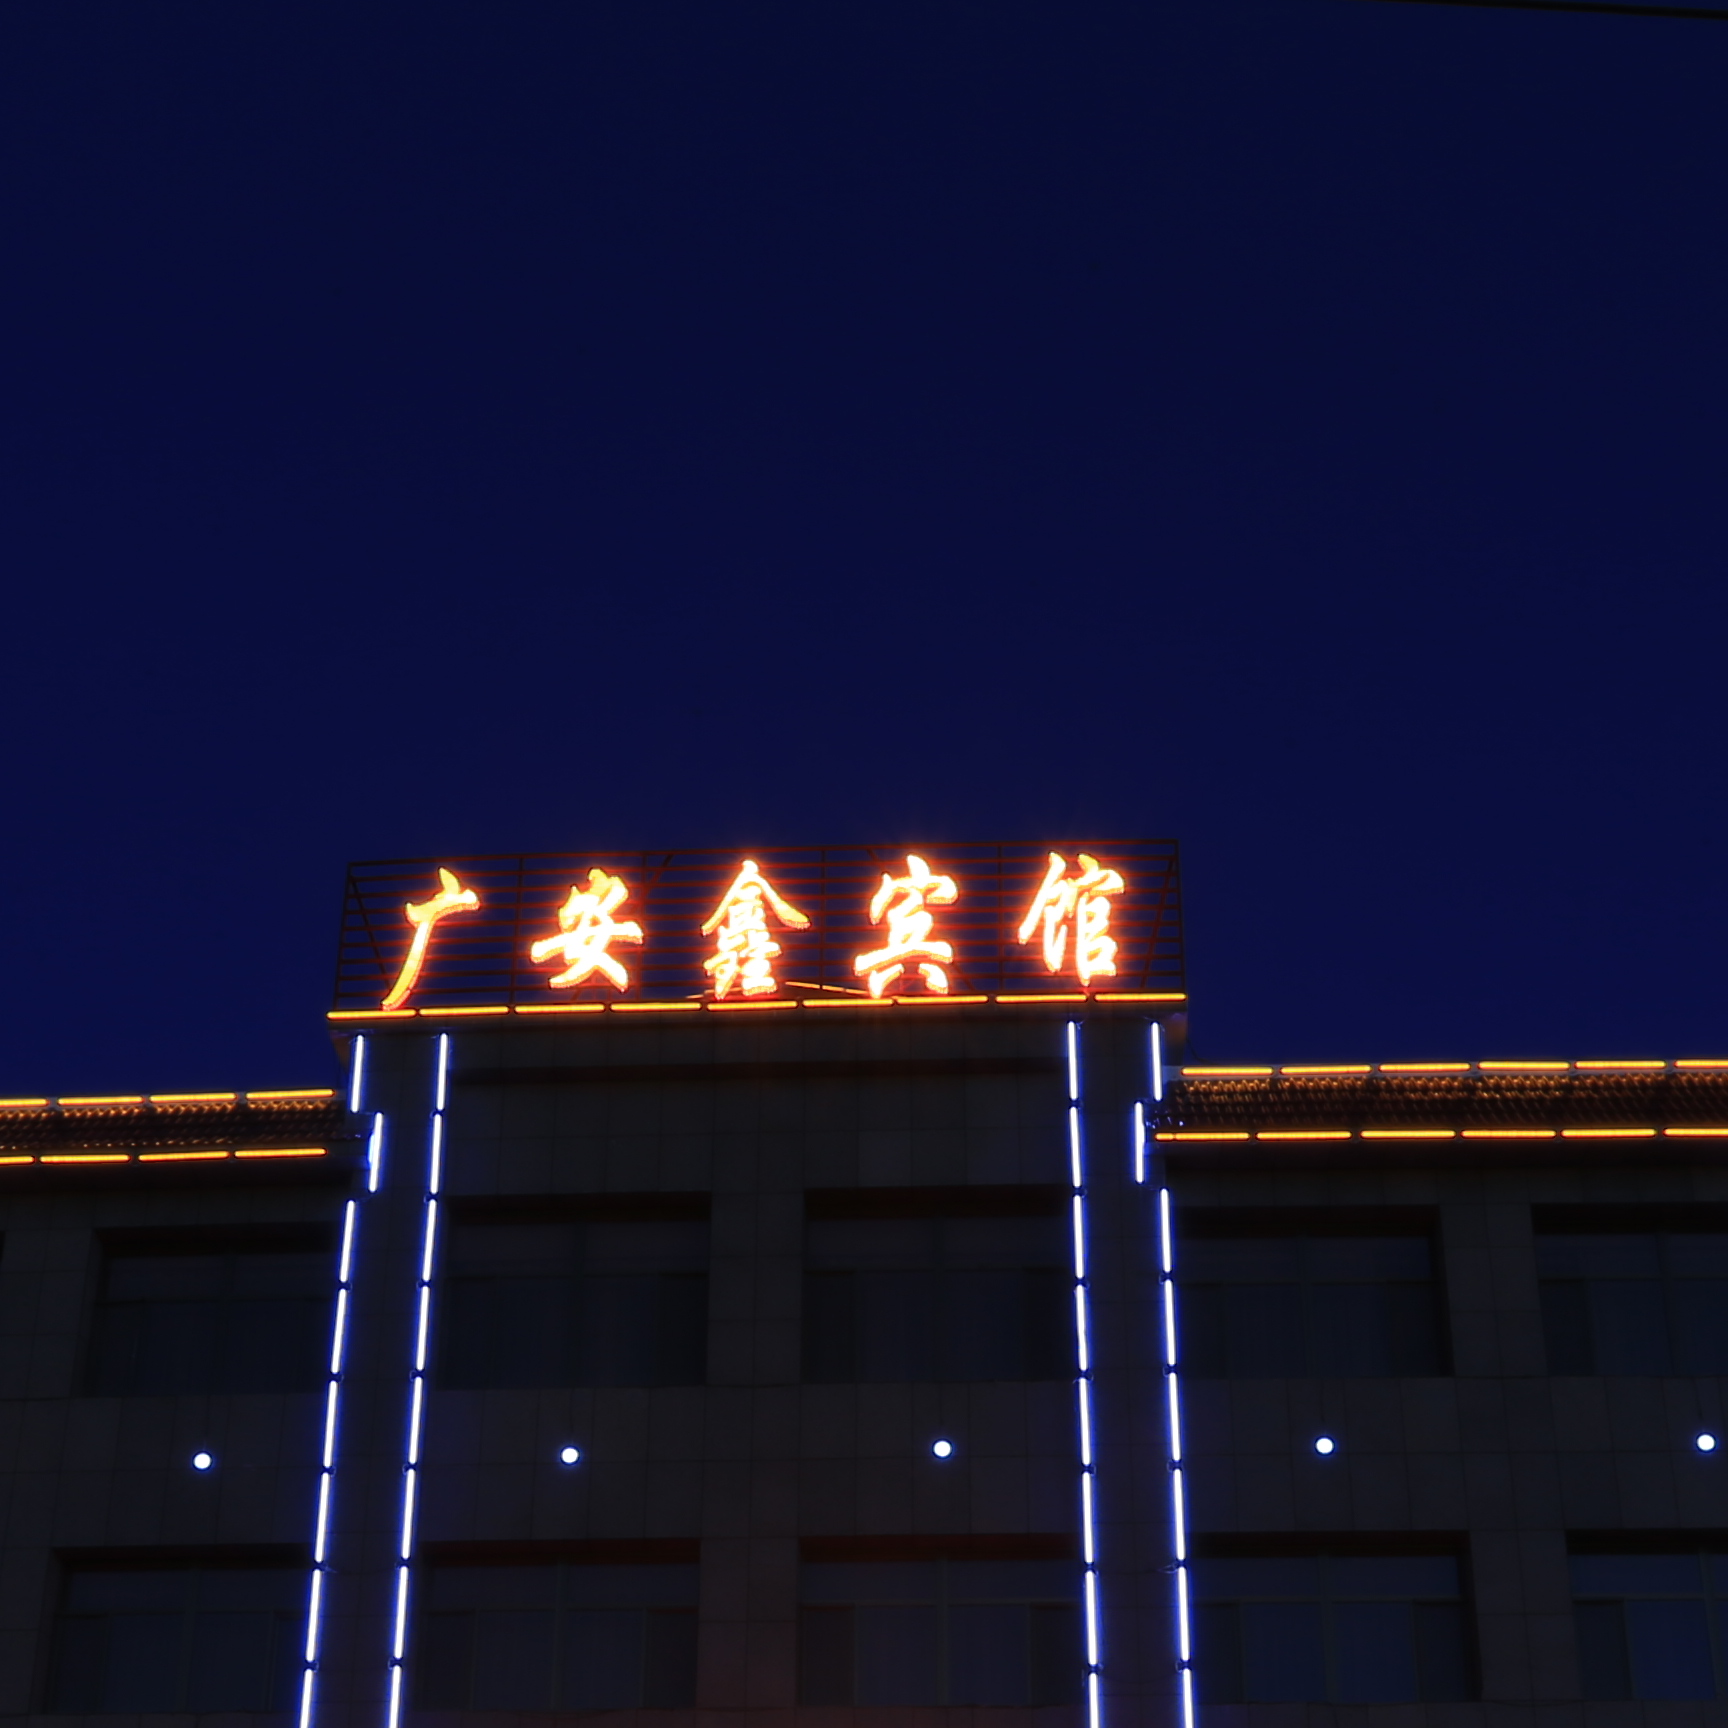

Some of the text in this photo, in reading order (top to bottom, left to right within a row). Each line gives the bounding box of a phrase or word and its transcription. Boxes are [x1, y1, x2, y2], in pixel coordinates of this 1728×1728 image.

[381, 852, 1125, 1011] 广安鑫宾馆
